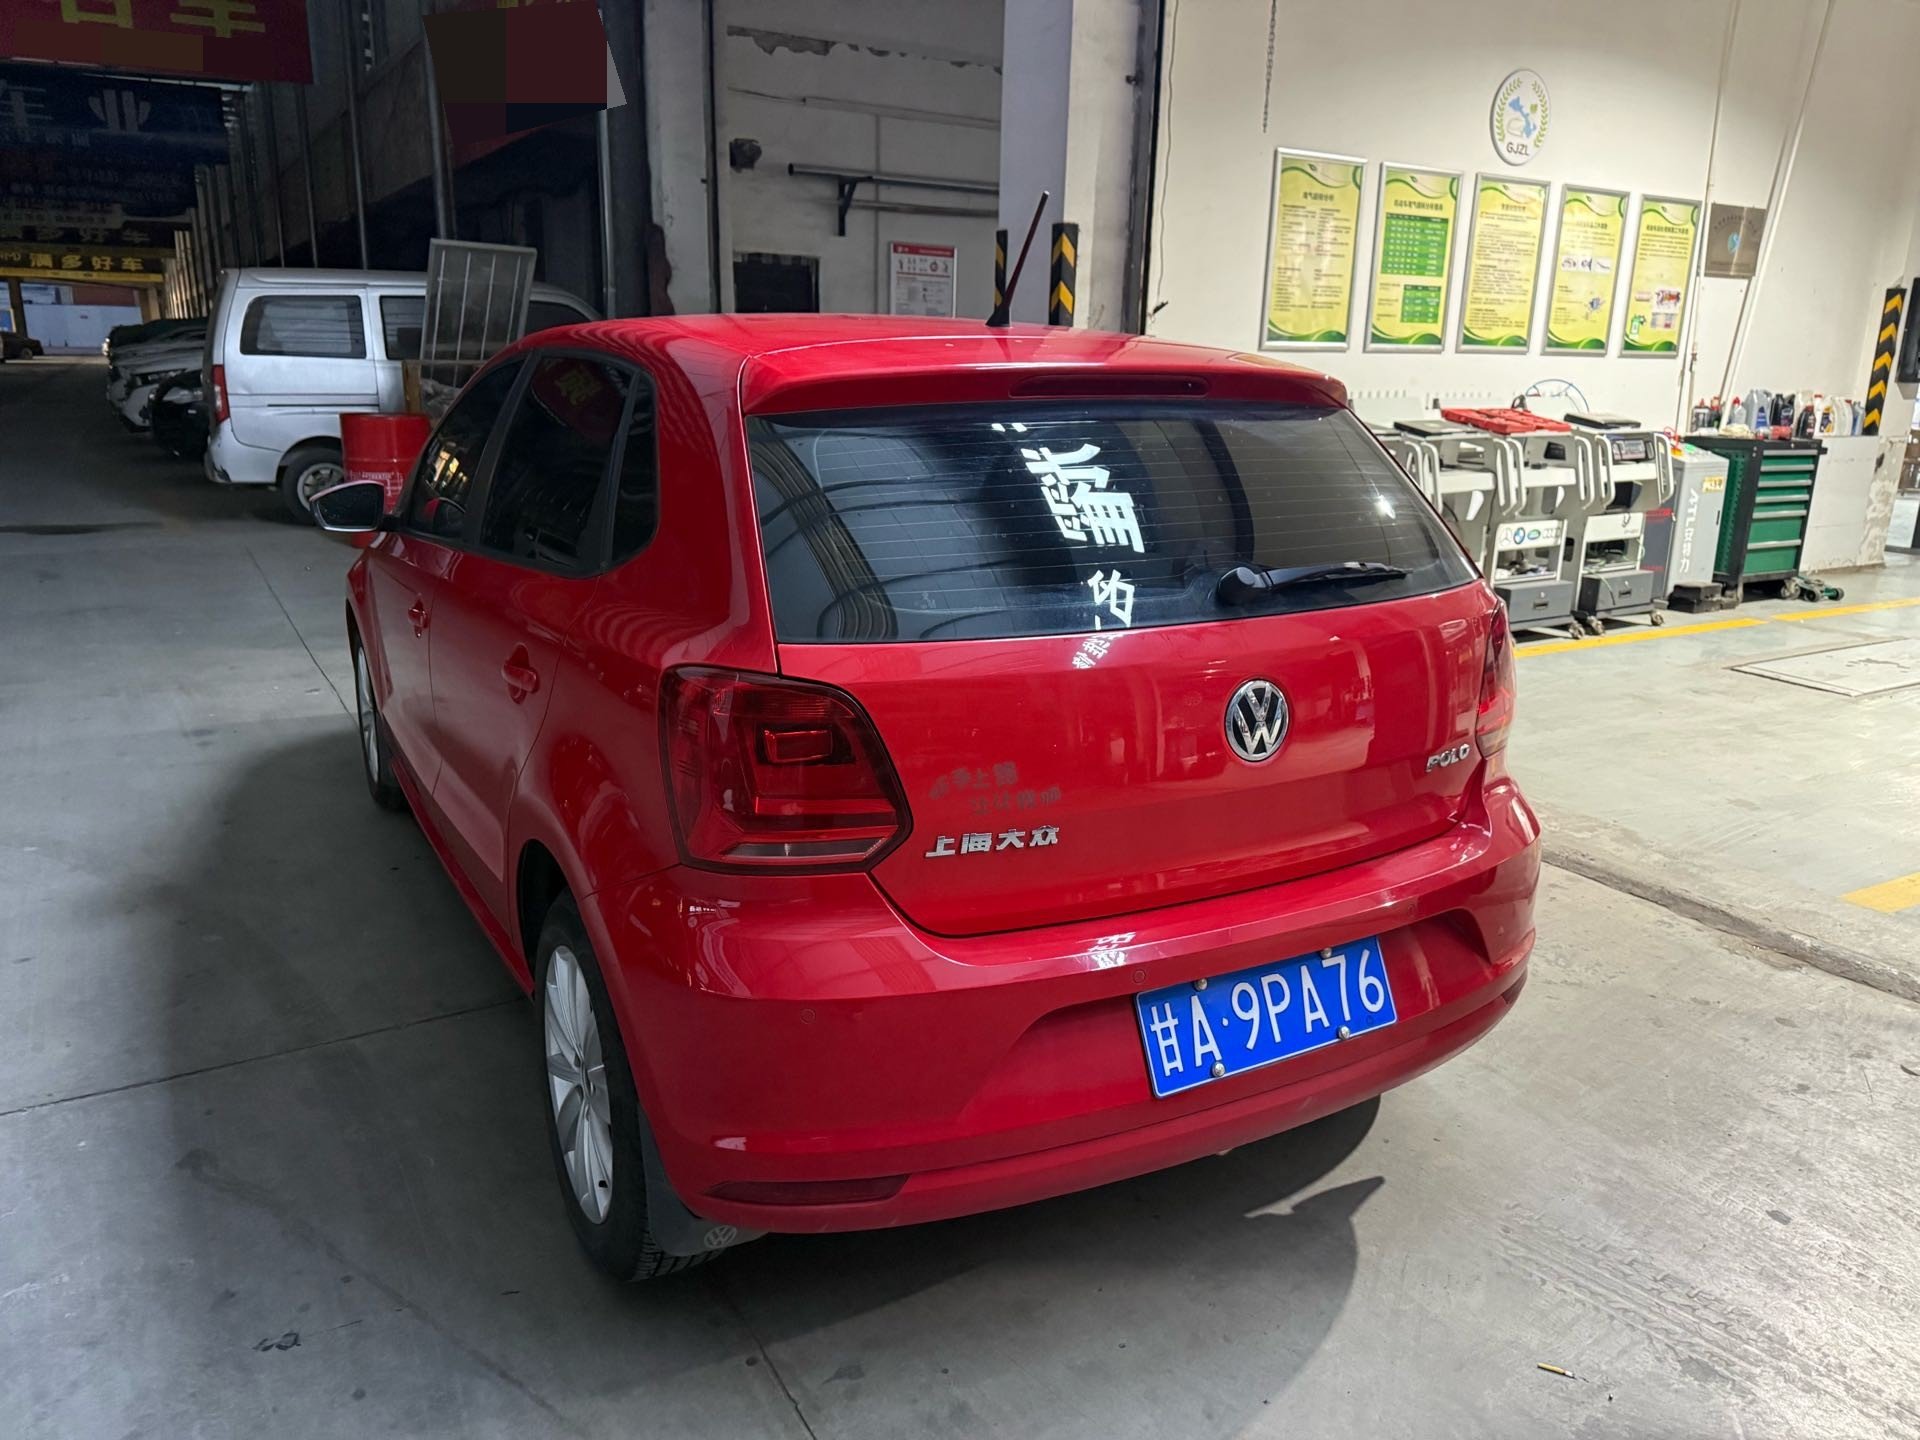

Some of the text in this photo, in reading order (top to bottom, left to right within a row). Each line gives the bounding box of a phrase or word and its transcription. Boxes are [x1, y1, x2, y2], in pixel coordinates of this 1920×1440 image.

[1506, 141, 1530, 157] GJZL
[1426, 743, 1470, 773] POLO
[925, 825, 1060, 857] 上海大众
[1150, 949, 1385, 1077] 甘A·9PA76
